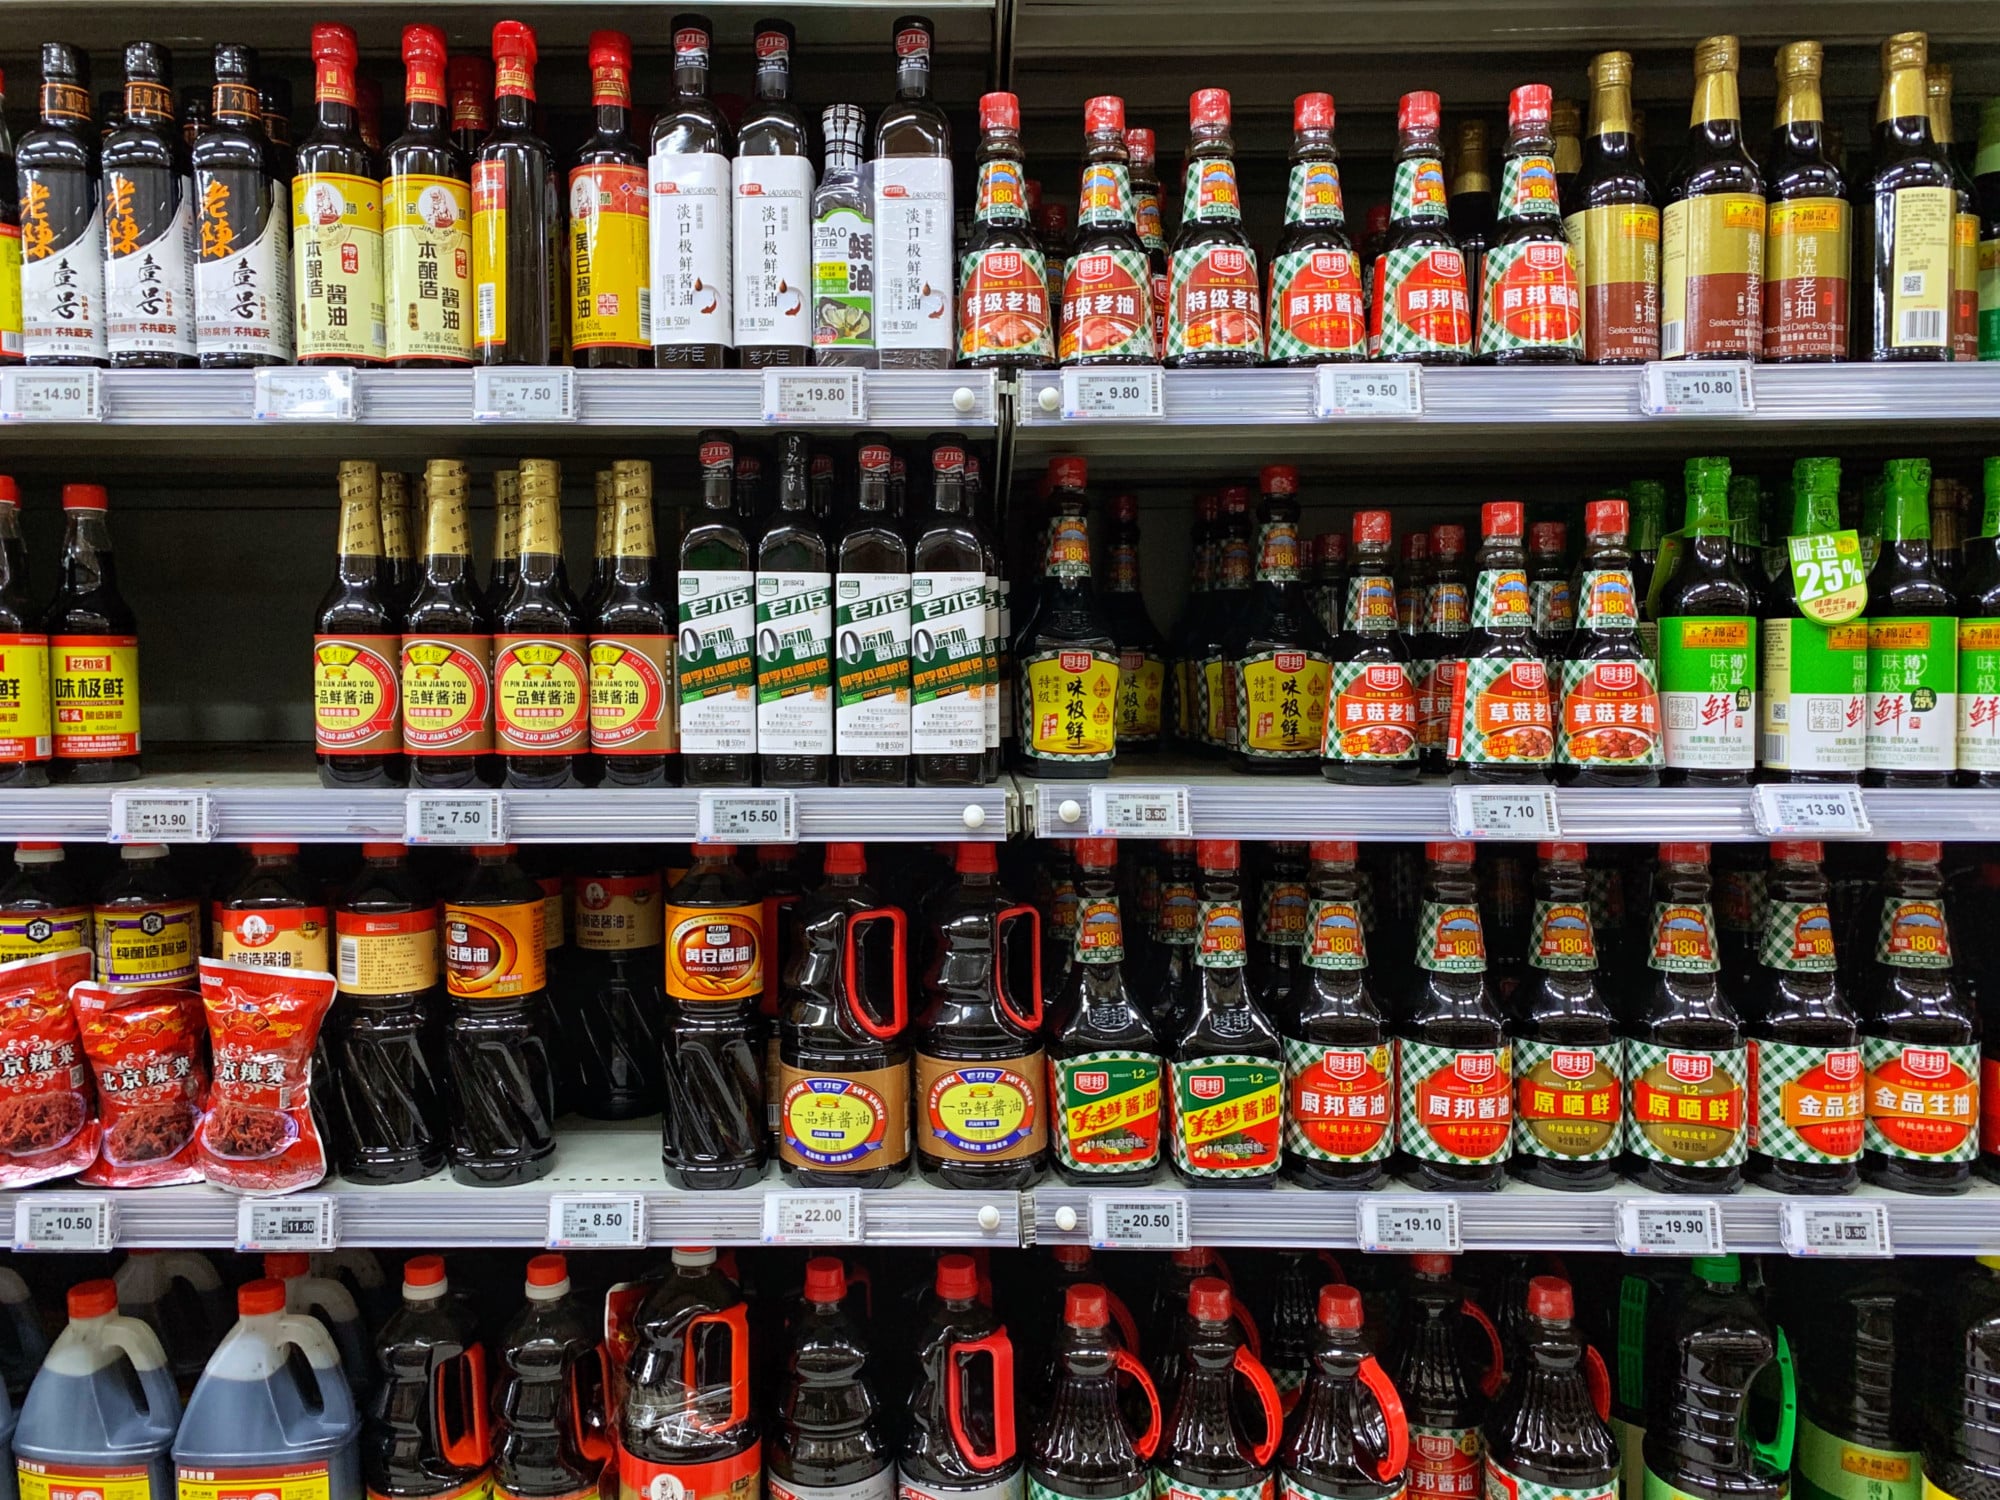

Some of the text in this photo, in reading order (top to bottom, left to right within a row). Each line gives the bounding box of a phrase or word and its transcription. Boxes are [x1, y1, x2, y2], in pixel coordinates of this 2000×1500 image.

[676, 204, 693, 306] 淡口极鲜酱油
[762, 206, 778, 308] 淡口极鲜酱油
[848, 233, 873, 293] 蚝油
[905, 208, 921, 311] 淡口极鲜酱油
[1315, 254, 1345, 270] 厨邦
[1529, 247, 1561, 264] 厨邦
[418, 241, 438, 299] 本酿造
[1795, 236, 1817, 319] 精选老抽
[326, 284, 348, 327] 酱油
[967, 291, 1042, 314] 特级老抽
[1290, 295, 1363, 317] 厨邦酱油
[1503, 288, 1579, 310] 厨邦酱油
[442, 286, 460, 330] 酱油
[1062, 294, 1135, 322] 特级老抽
[1792, 322, 1826, 331] Dark Soy
[43, 387, 81, 401] 14.90
[520, 387, 551, 401] 7.50
[806, 388, 845, 402] 19.80
[1109, 386, 1140, 400] 9.80
[1366, 384, 1398, 397] 9.50
[1693, 381, 1733, 395] 10.80
[1797, 559, 1863, 601] 25%
[689, 591, 750, 620] 老才臣
[768, 591, 829, 619] 老才臣
[848, 591, 909, 621] 老才臣
[922, 591, 983, 620] 老才臣
[1701, 625, 1738, 639] 李錦記
[1878, 625, 1912, 640] 李錦記
[1371, 668, 1400, 684] 厨邦
[1515, 667, 1543, 683] 厨邦
[1599, 667, 1634, 684] 厨邦
[56, 678, 124, 698] 味极鲜
[404, 690, 467, 706] 一品鲜酱油
[504, 690, 575, 705] 一品鲜酱油
[1914, 696, 1934, 708] 25%
[1065, 677, 1086, 745] 味极鲜
[1281, 679, 1301, 745] 味极鲜
[1346, 704, 1415, 723] 草菇老抽
[1574, 704, 1655, 724] 草菇老抽
[1811, 700, 1840, 716] 特级
[1812, 716, 1839, 731] 酱油
[525, 727, 573, 741] ZAO JIANG YOU
[451, 811, 481, 824] 7.50
[740, 810, 778, 823] 15.50
[1145, 810, 1166, 820] 8.90
[1504, 806, 1534, 818] 7.10
[1805, 803, 1846, 816] 13.90
[152, 814, 186, 826] 13.90
[117, 940, 187, 959] 纯酿造酱油
[685, 947, 749, 963] 黄豆酱油
[1328, 1055, 1362, 1074] 厨邦
[1459, 1057, 1491, 1076] 厨邦
[1556, 1054, 1590, 1073] 厨邦
[1671, 1057, 1709, 1076] 厨邦
[1830, 1055, 1858, 1072] 厨邦
[1909, 1052, 1944, 1071] 厨邦
[101, 1056, 191, 1092] 北京辣菜
[1078, 1075, 1105, 1090] 厨邦
[1132, 1068, 1145, 1080] 1.2
[1248, 1073, 1263, 1084] 1.2
[1005, 1073, 1033, 1107] SOY SAUCE
[1194, 1079, 1220, 1095] 厨邦
[1338, 1082, 1353, 1092] 1.3
[1469, 1084, 1484, 1094] 1.3
[1567, 1081, 1582, 1091] 1.2
[1682, 1084, 1698, 1095] 1.2
[852, 1086, 884, 1120] SOY SAUCE
[942, 1095, 1023, 1117] 一品鲜酱油
[1300, 1093, 1385, 1116] 厨邦酱油
[1428, 1095, 1509, 1120] 厨邦酱油
[1533, 1092, 1611, 1116] 原晒鲜
[1648, 1095, 1730, 1122] 原晒鲜
[1875, 1088, 1969, 1117] 金品生抽
[792, 1110, 870, 1128] 一品鲜酱油
[1072, 1093, 1158, 1132] 美味鲜酱油
[1188, 1094, 1278, 1137] 美味鲜酱油
[55, 1217, 92, 1230] 10.50
[593, 1214, 622, 1226] 8.50
[804, 1209, 842, 1222] 22.00
[1133, 1215, 1170, 1228] 20.50
[288, 1221, 314, 1232] 11.80
[1404, 1218, 1442, 1231] 19.10
[1665, 1221, 1703, 1233] 19.90
